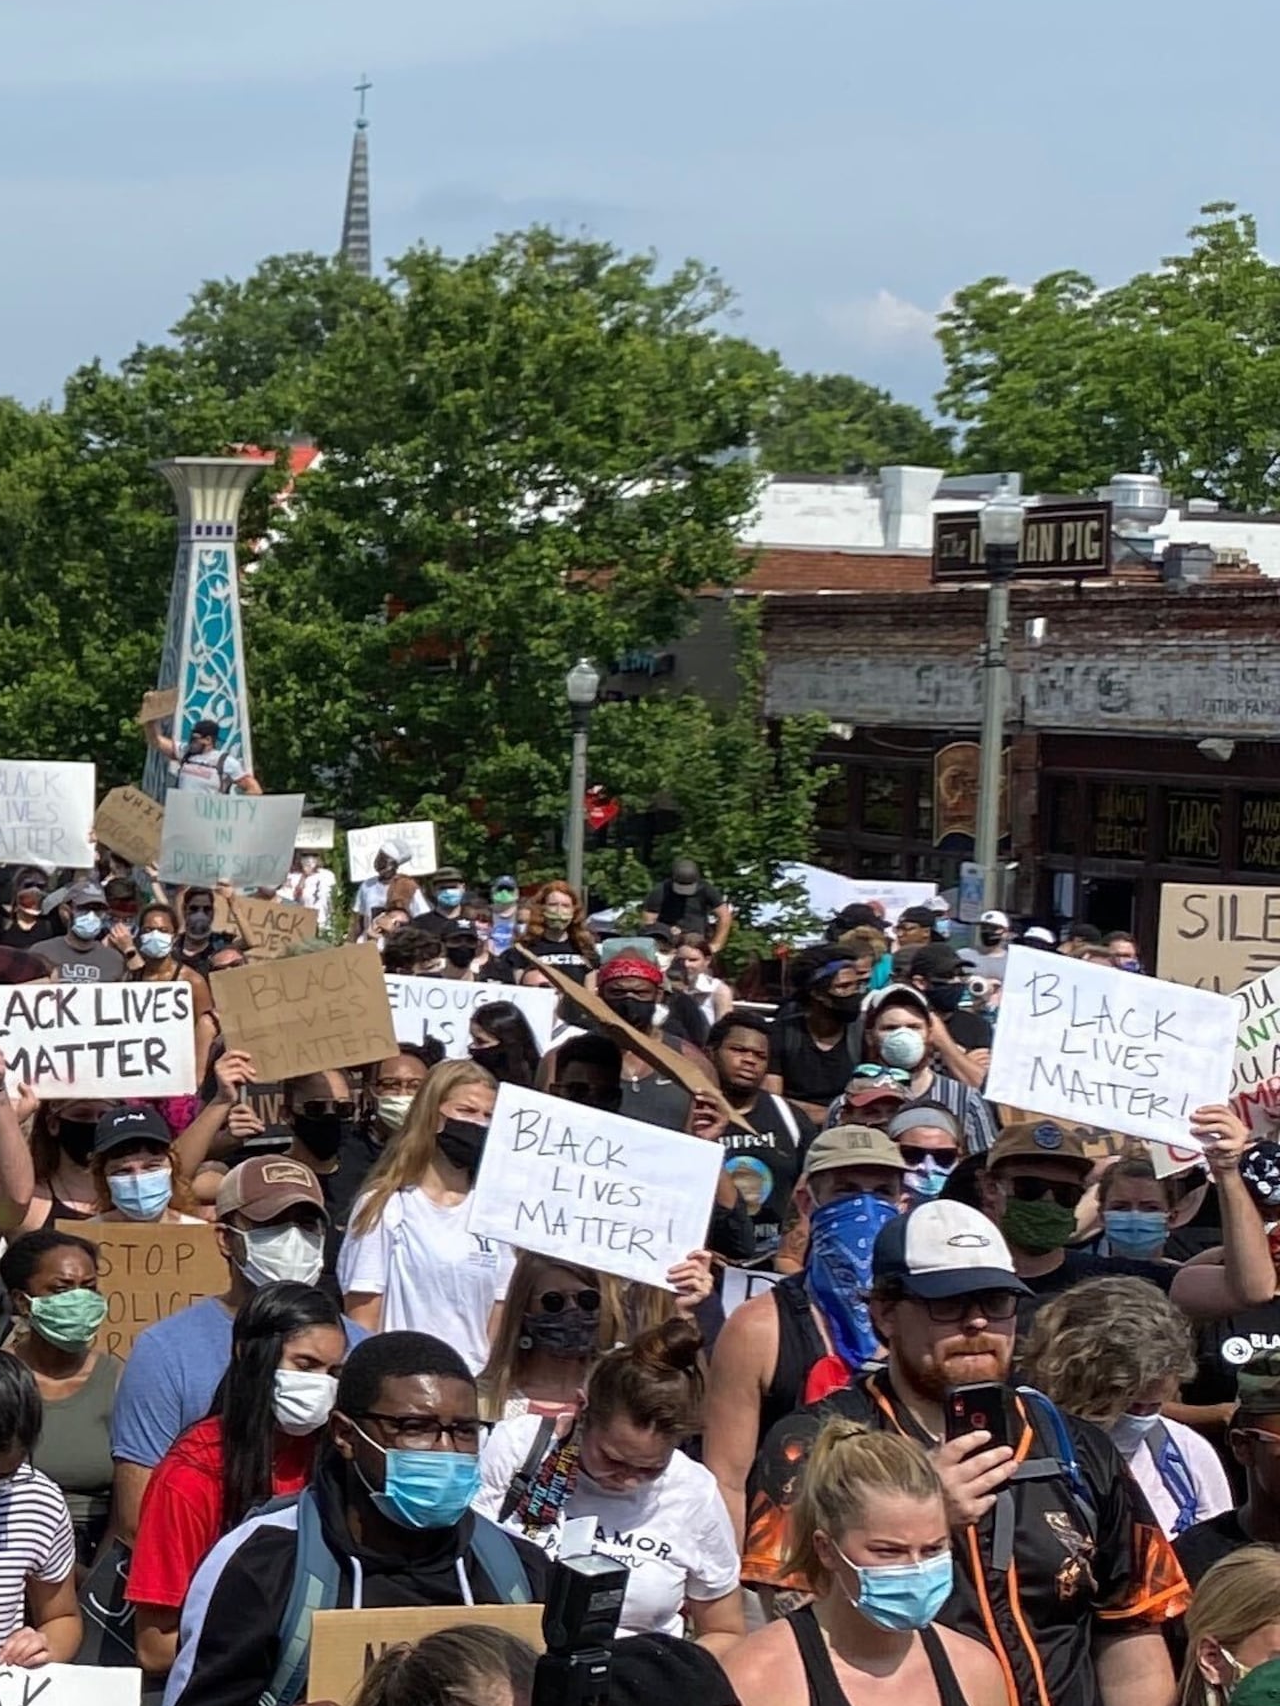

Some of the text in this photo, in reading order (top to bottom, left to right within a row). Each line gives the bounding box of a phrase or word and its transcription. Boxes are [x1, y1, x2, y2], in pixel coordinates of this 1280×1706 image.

[1061, 521, 1101, 561] PIG
[194, 796, 258, 821] UNITY
[1168, 800, 1221, 857] TAPAS
[216, 825, 232, 843] IN
[172, 852, 282, 880] DIVERSITY
[95, 984, 189, 1028] LIVES
[247, 956, 371, 1012] BLACK
[386, 982, 516, 1011] ENOUG
[238, 997, 368, 1042] LIVES
[1025, 972, 1183, 1042] BLACK
[257, 1028, 389, 1068] MATTER
[423, 1018, 456, 1045] IS
[3, 1036, 172, 1087] MATTER
[1061, 1030, 1164, 1078] LIVES
[1030, 1055, 1189, 1121] MATTER!
[509, 1108, 627, 1169] BLACK
[553, 1172, 643, 1207] LIVES
[515, 1200, 674, 1262] MATTER!
[96, 1241, 195, 1277] STOP
